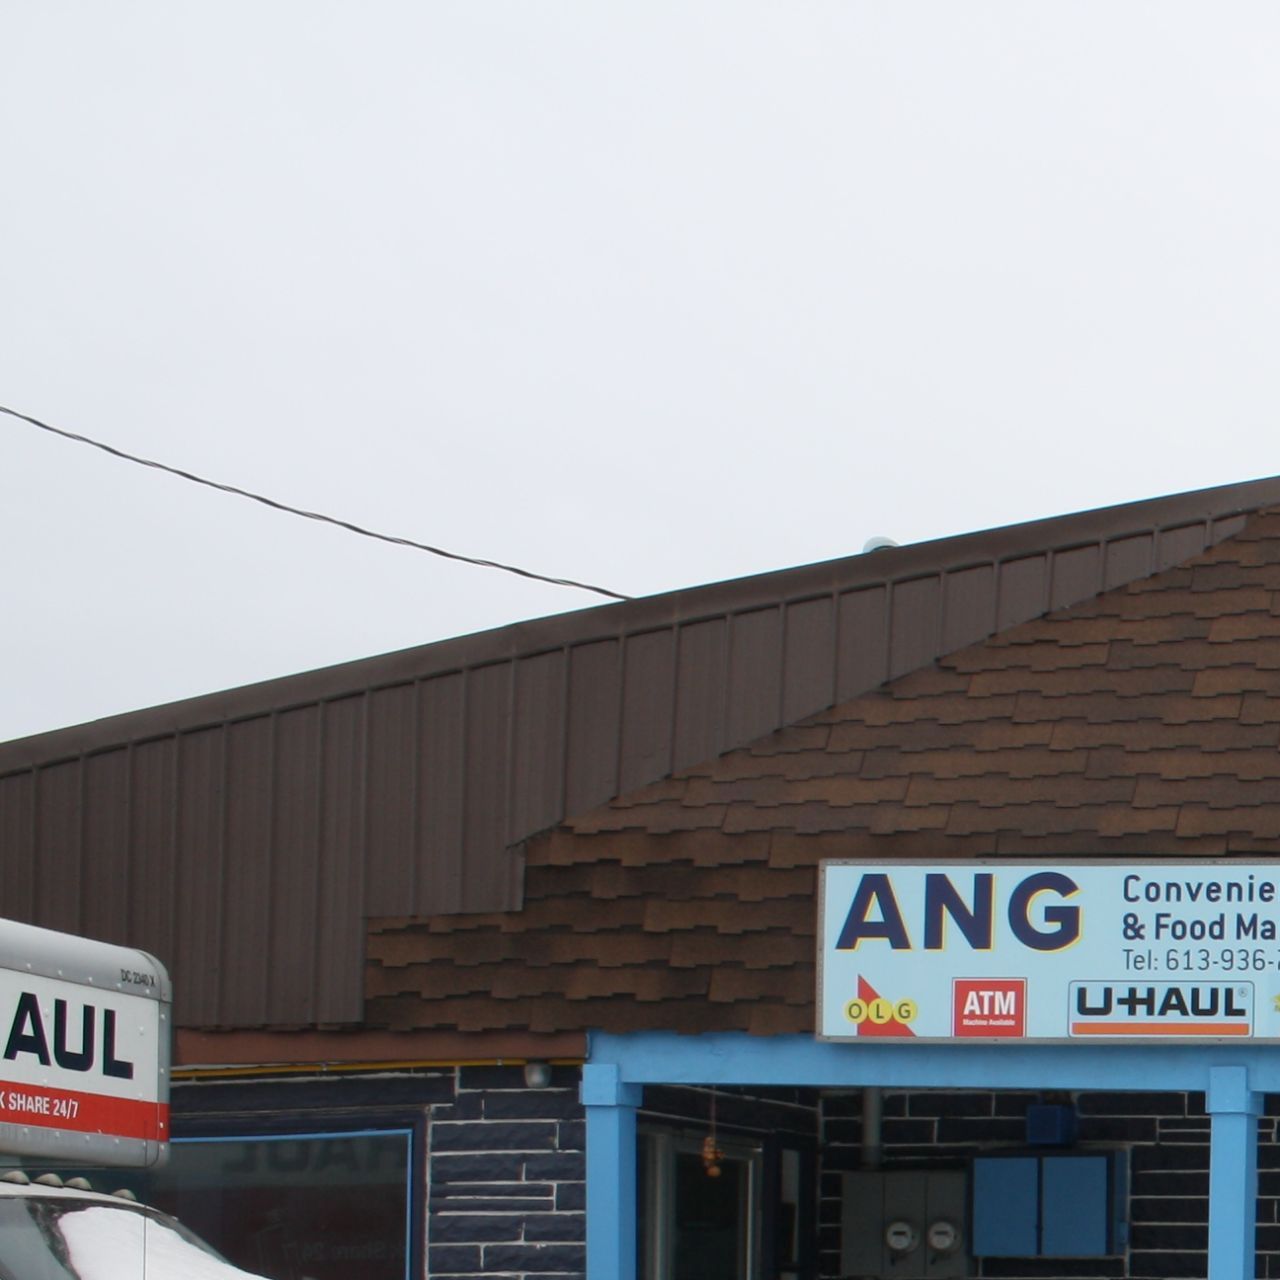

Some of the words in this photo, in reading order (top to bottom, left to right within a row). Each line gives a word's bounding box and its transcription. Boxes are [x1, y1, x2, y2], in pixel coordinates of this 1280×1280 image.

[835, 871, 1082, 952] ANG
[1122, 912, 1146, 940] &
[1154, 912, 1225, 940] Food
[1122, 948, 1159, 970] Tel:
[848, 1002, 912, 1020] OLG
[963, 991, 1016, 1015] ATM
[1077, 987, 1247, 1017] U-HAUL
[8, 1092, 50, 1115] SHARE
[53, 1098, 79, 1119] 24/7
